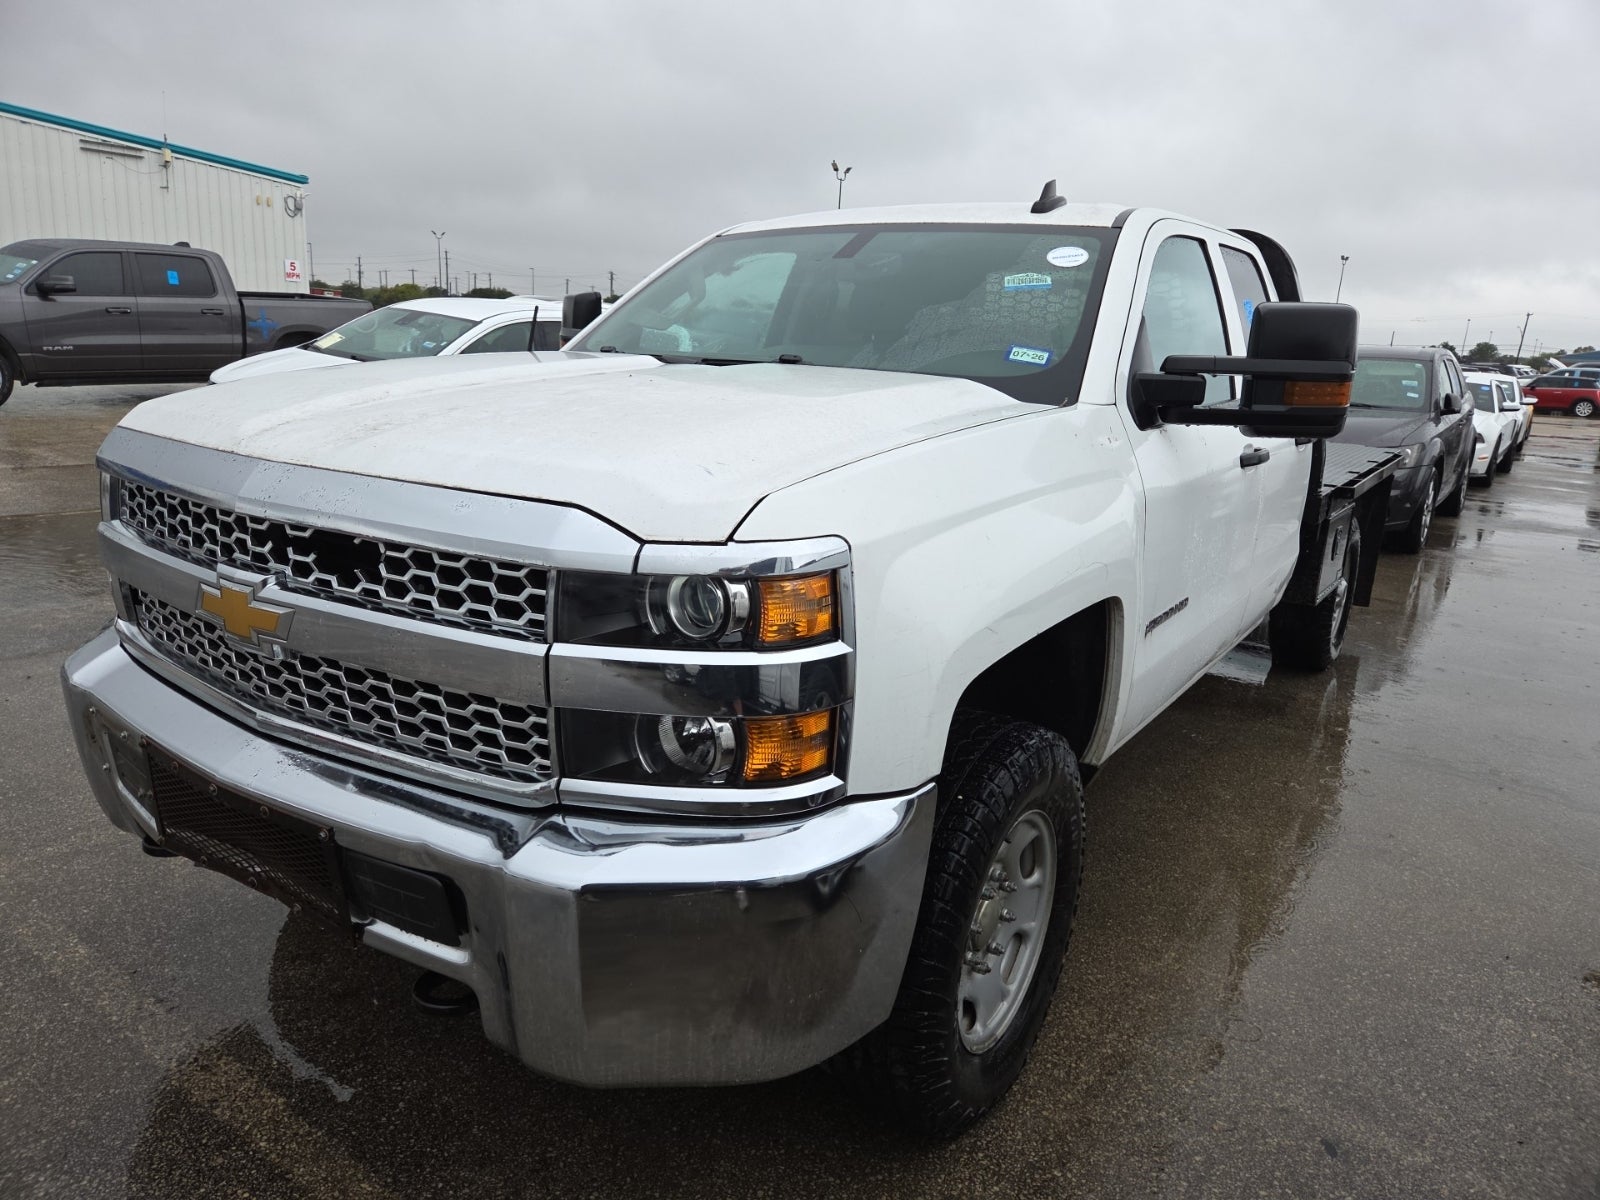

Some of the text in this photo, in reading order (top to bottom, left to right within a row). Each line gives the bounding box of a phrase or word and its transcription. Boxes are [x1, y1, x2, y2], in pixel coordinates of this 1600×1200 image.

[290, 261, 296, 271] 5
[286, 271, 301, 280] MPH
[1012, 349, 1046, 362] 07-26
